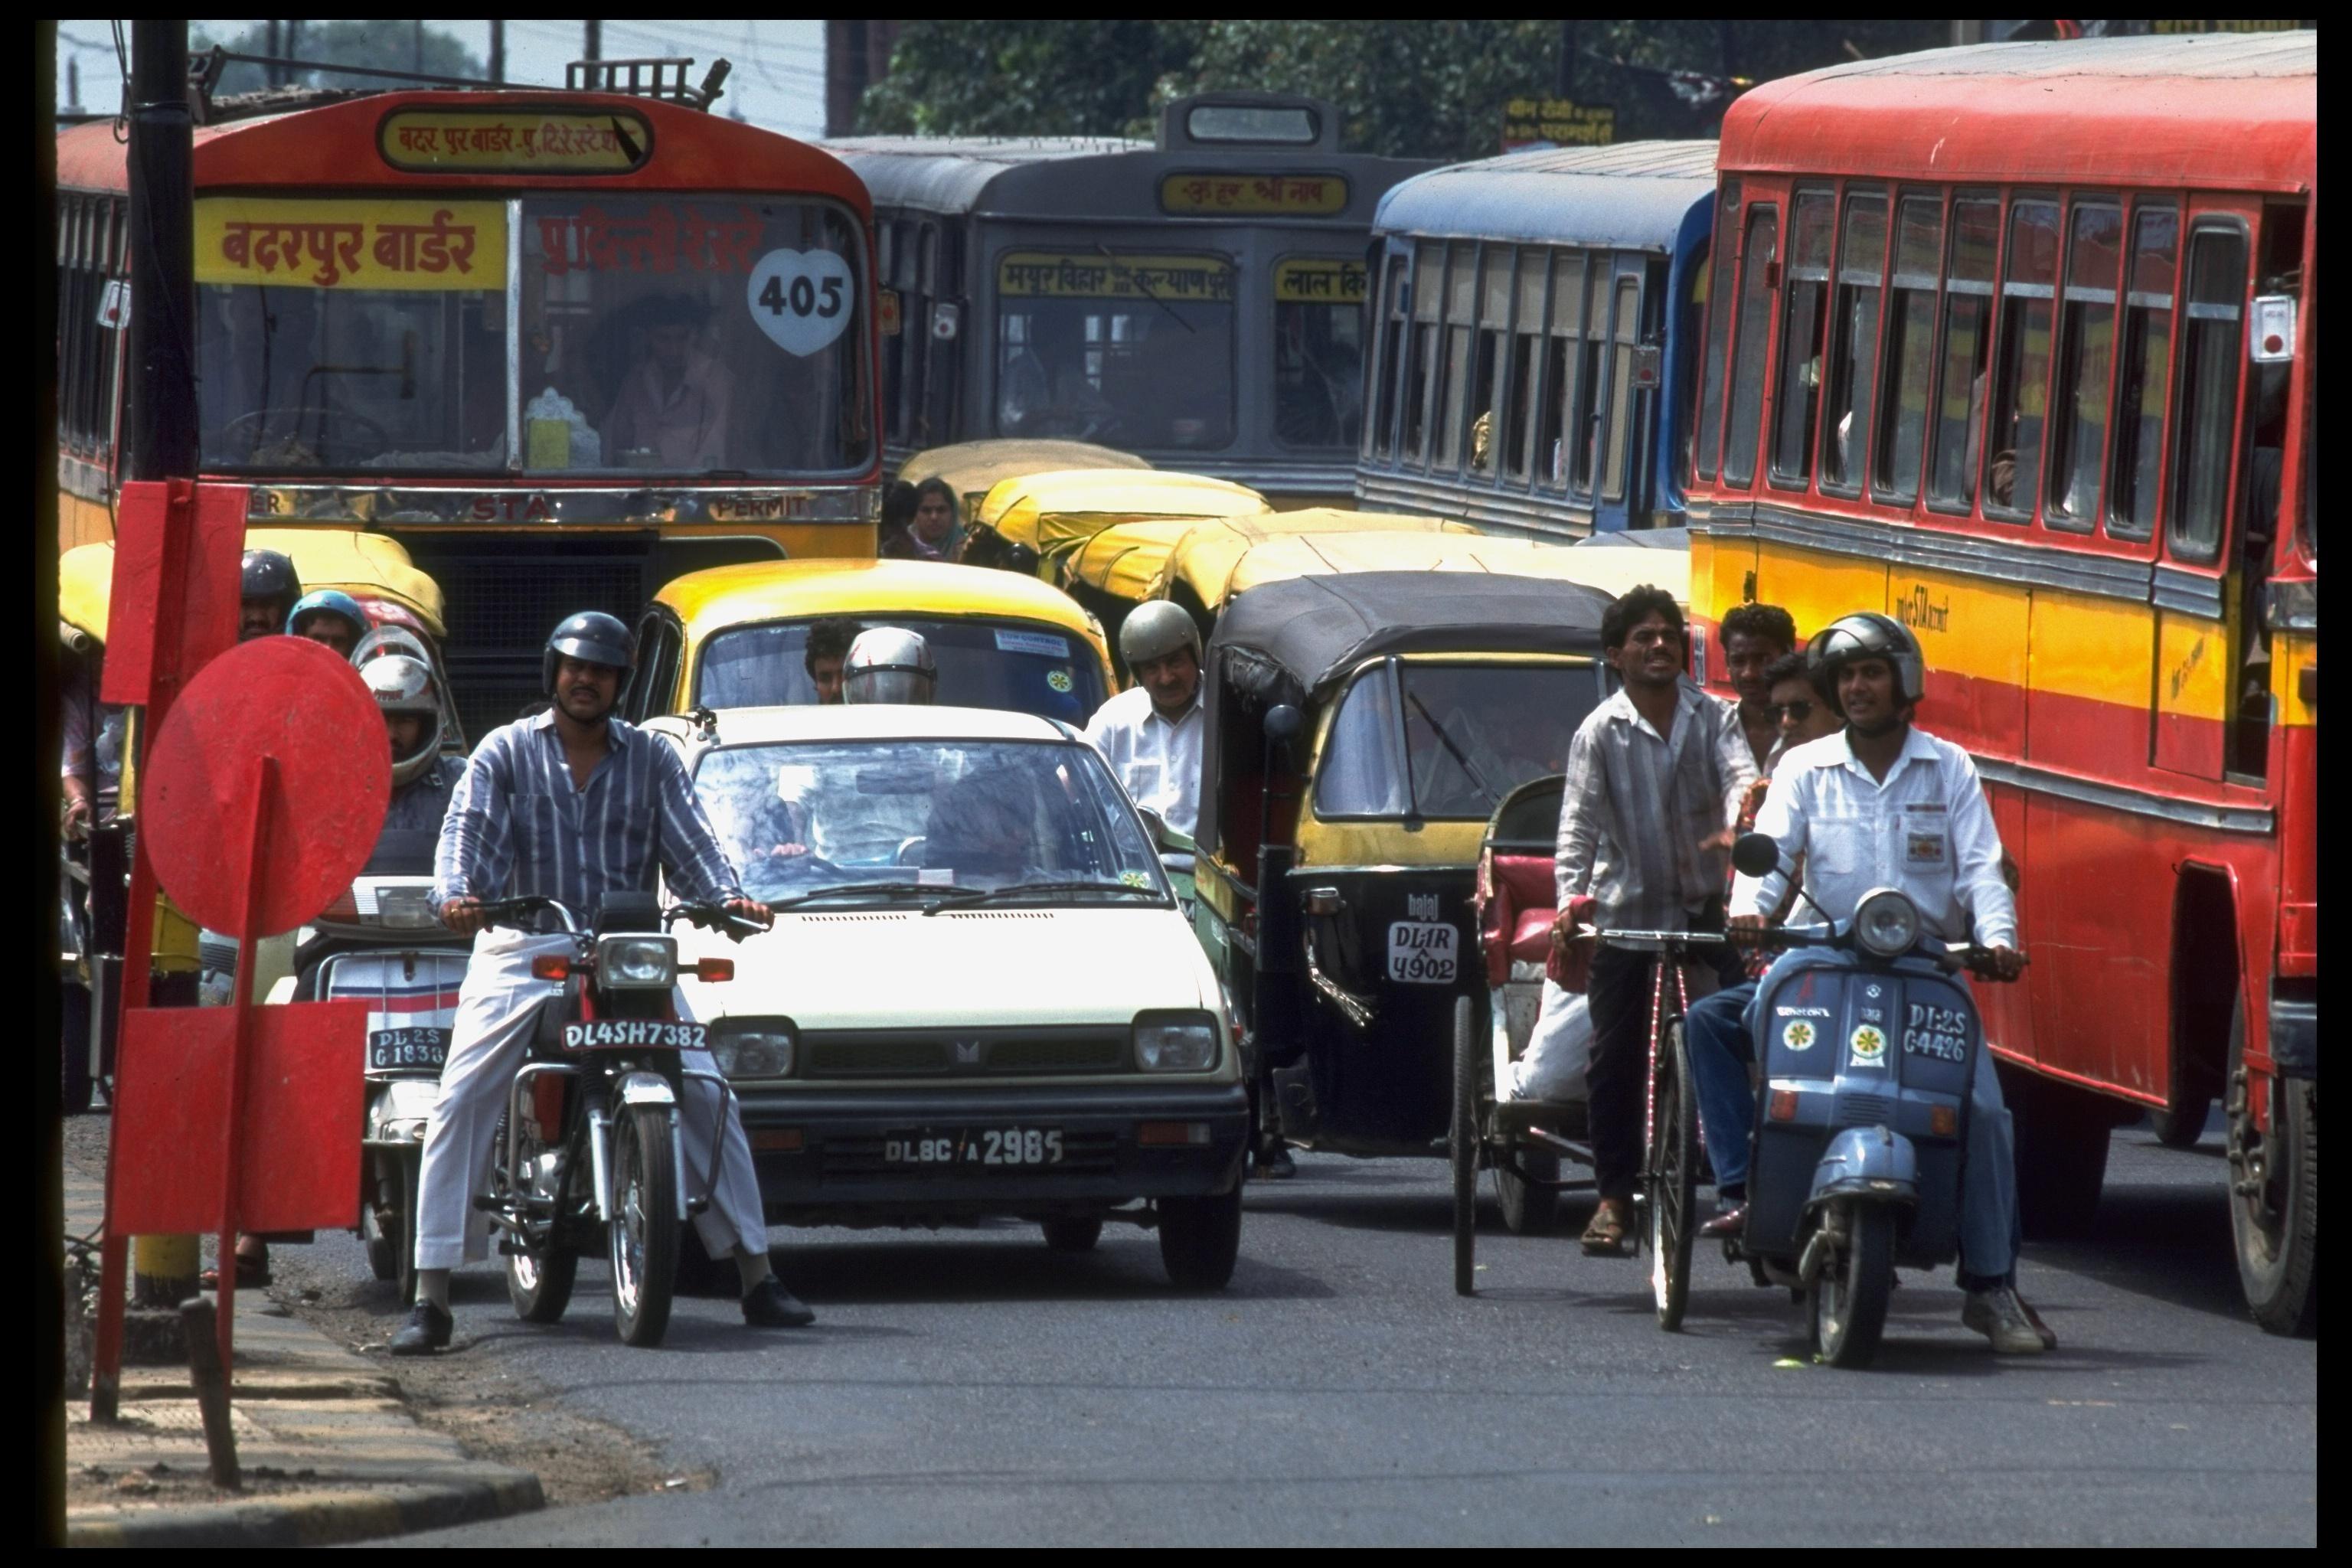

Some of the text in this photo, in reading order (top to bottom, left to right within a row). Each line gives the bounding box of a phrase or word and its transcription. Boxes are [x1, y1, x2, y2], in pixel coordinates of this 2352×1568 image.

[222, 209, 476, 287] बदरपुर बार्डर
[759, 275, 844, 318] 405
[472, 495, 551, 521] STA
[717, 495, 808, 518] PERMIT
[1408, 893, 1439, 921] bajaj
[1393, 957, 1455, 980] 4902
[565, 1021, 706, 1048] DL4SH7382
[983, 1130, 1064, 1165] 2985
